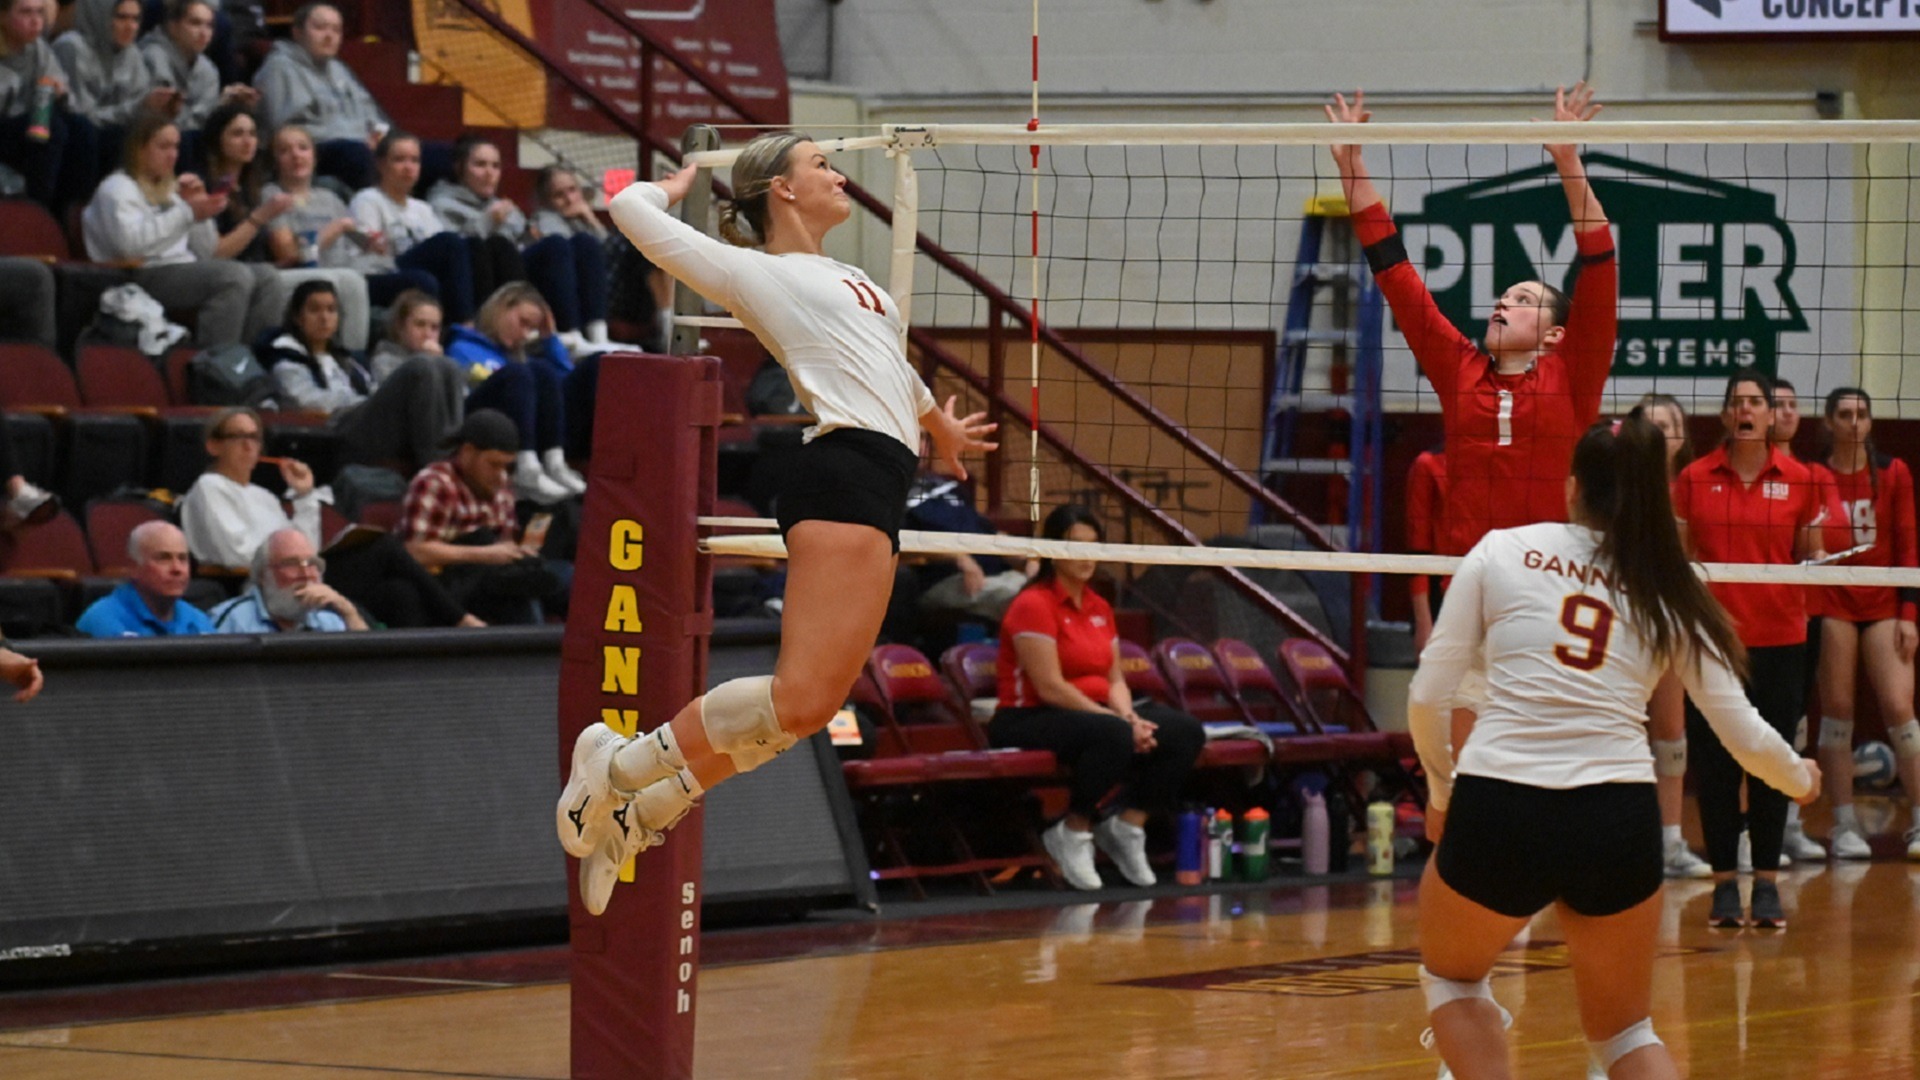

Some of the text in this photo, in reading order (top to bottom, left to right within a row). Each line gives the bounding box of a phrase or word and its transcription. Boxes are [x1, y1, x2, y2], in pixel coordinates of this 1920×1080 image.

[1762, 0, 1920, 19] CONCEPT
[841, 279, 886, 317] 11
[1610, 338, 1757, 367] STEMS
[1497, 389, 1513, 446] 1
[1524, 549, 1631, 595] GANN
[1553, 591, 1615, 674] 9
[602, 518, 644, 883] GANN
[676, 881, 696, 1014] senoh
